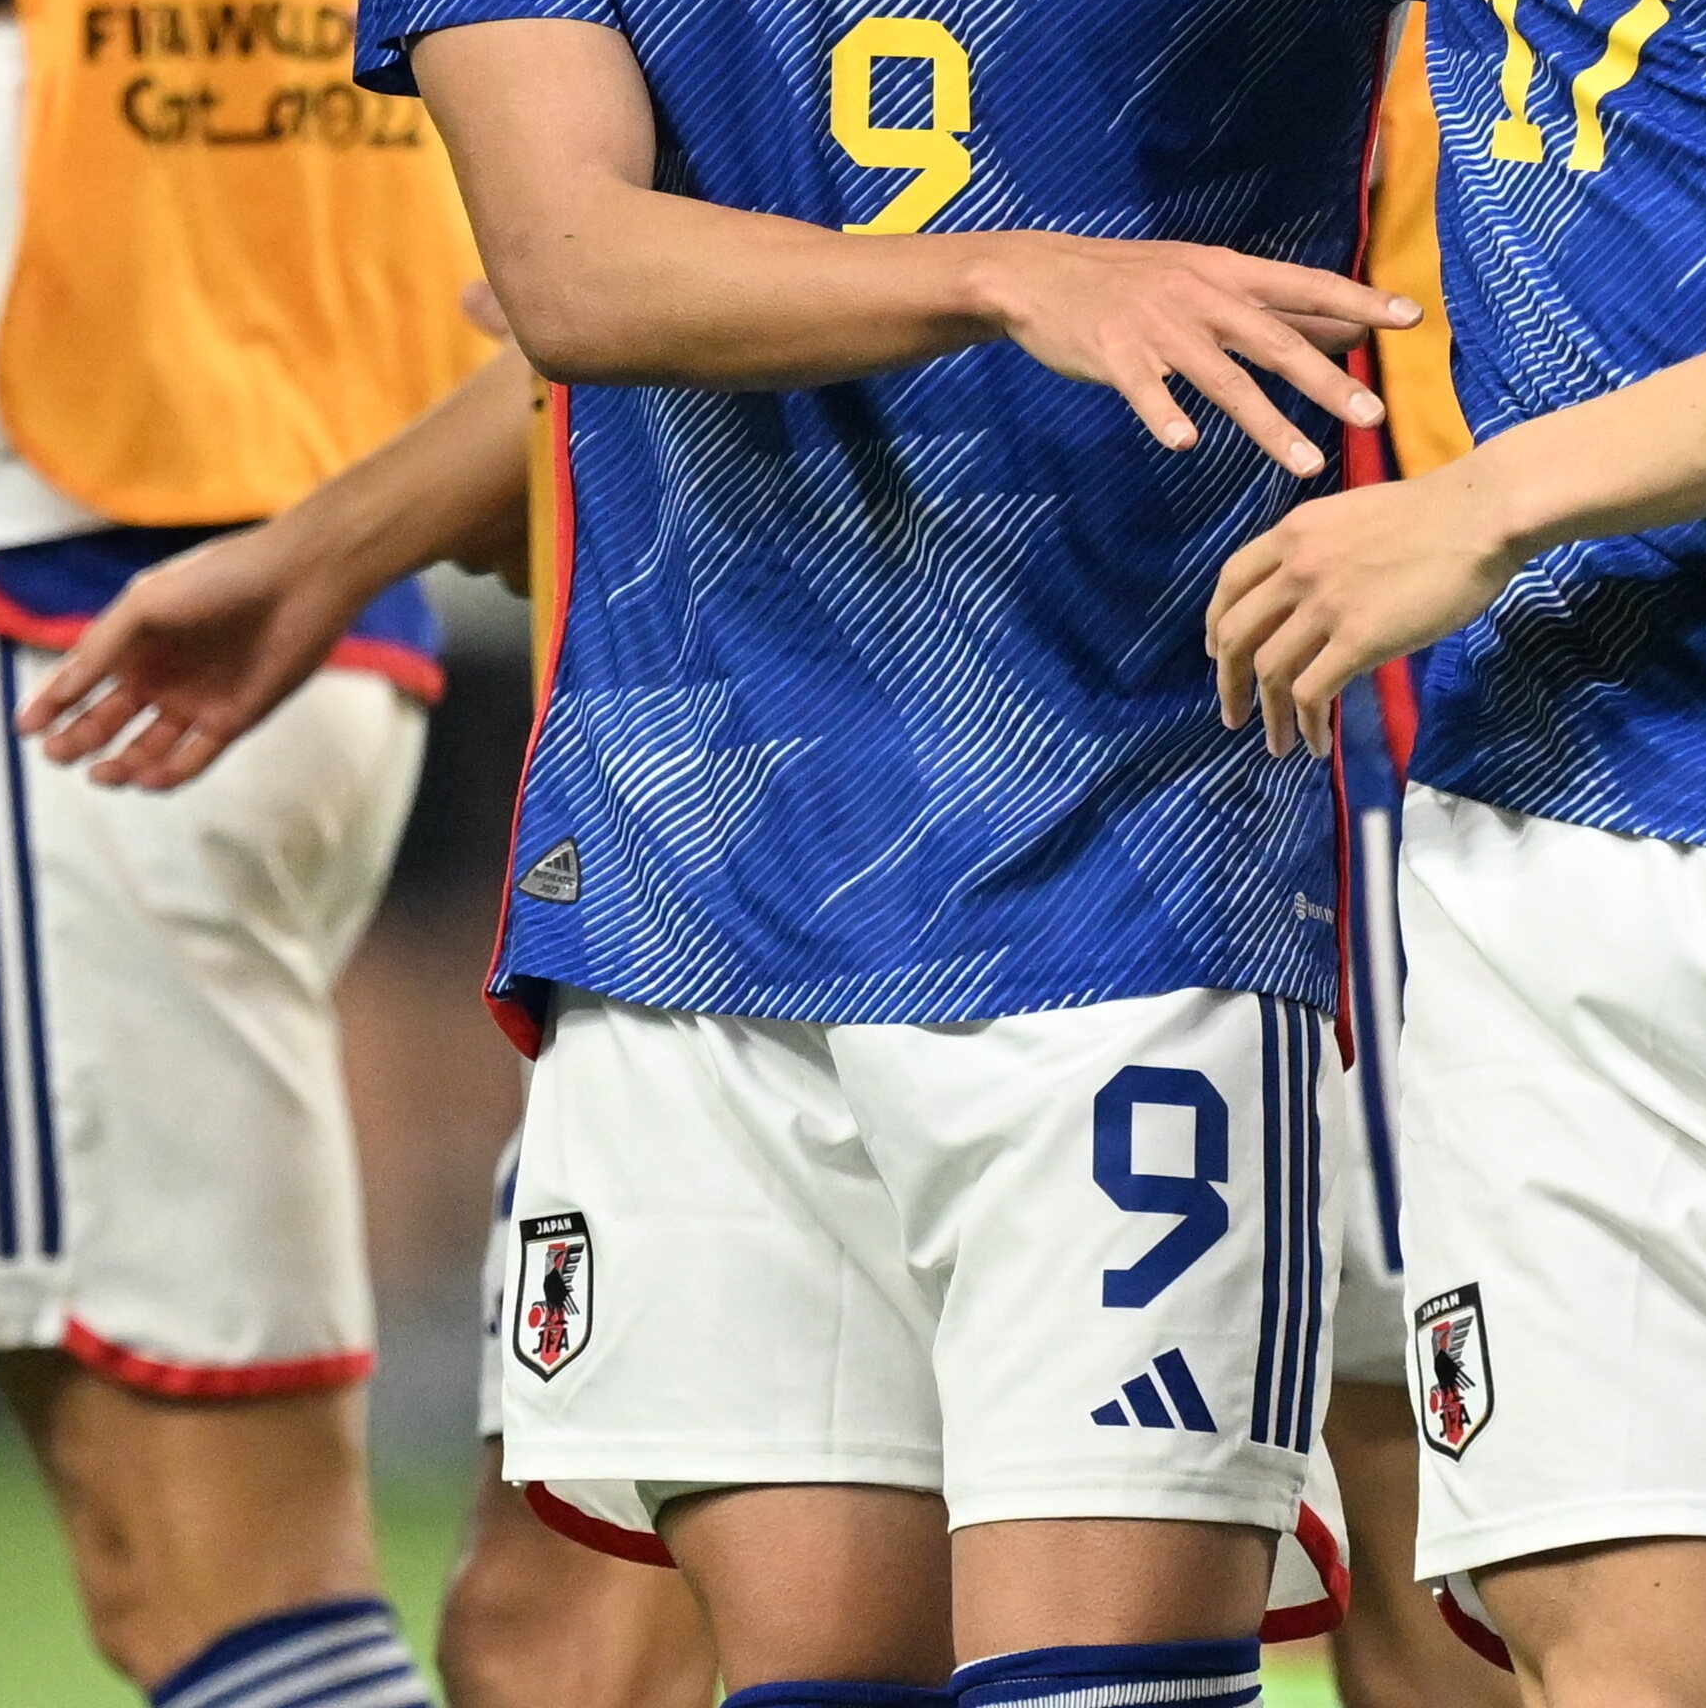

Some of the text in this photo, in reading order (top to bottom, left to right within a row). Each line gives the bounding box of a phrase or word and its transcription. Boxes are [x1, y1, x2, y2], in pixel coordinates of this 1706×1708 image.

[830, 17, 971, 235] 9
[1093, 1065, 1229, 1308] 9
[535, 1217, 573, 1235] JAPAN
[1421, 1292, 1460, 1322] JAPAN
[532, 1328, 569, 1355] JFA
